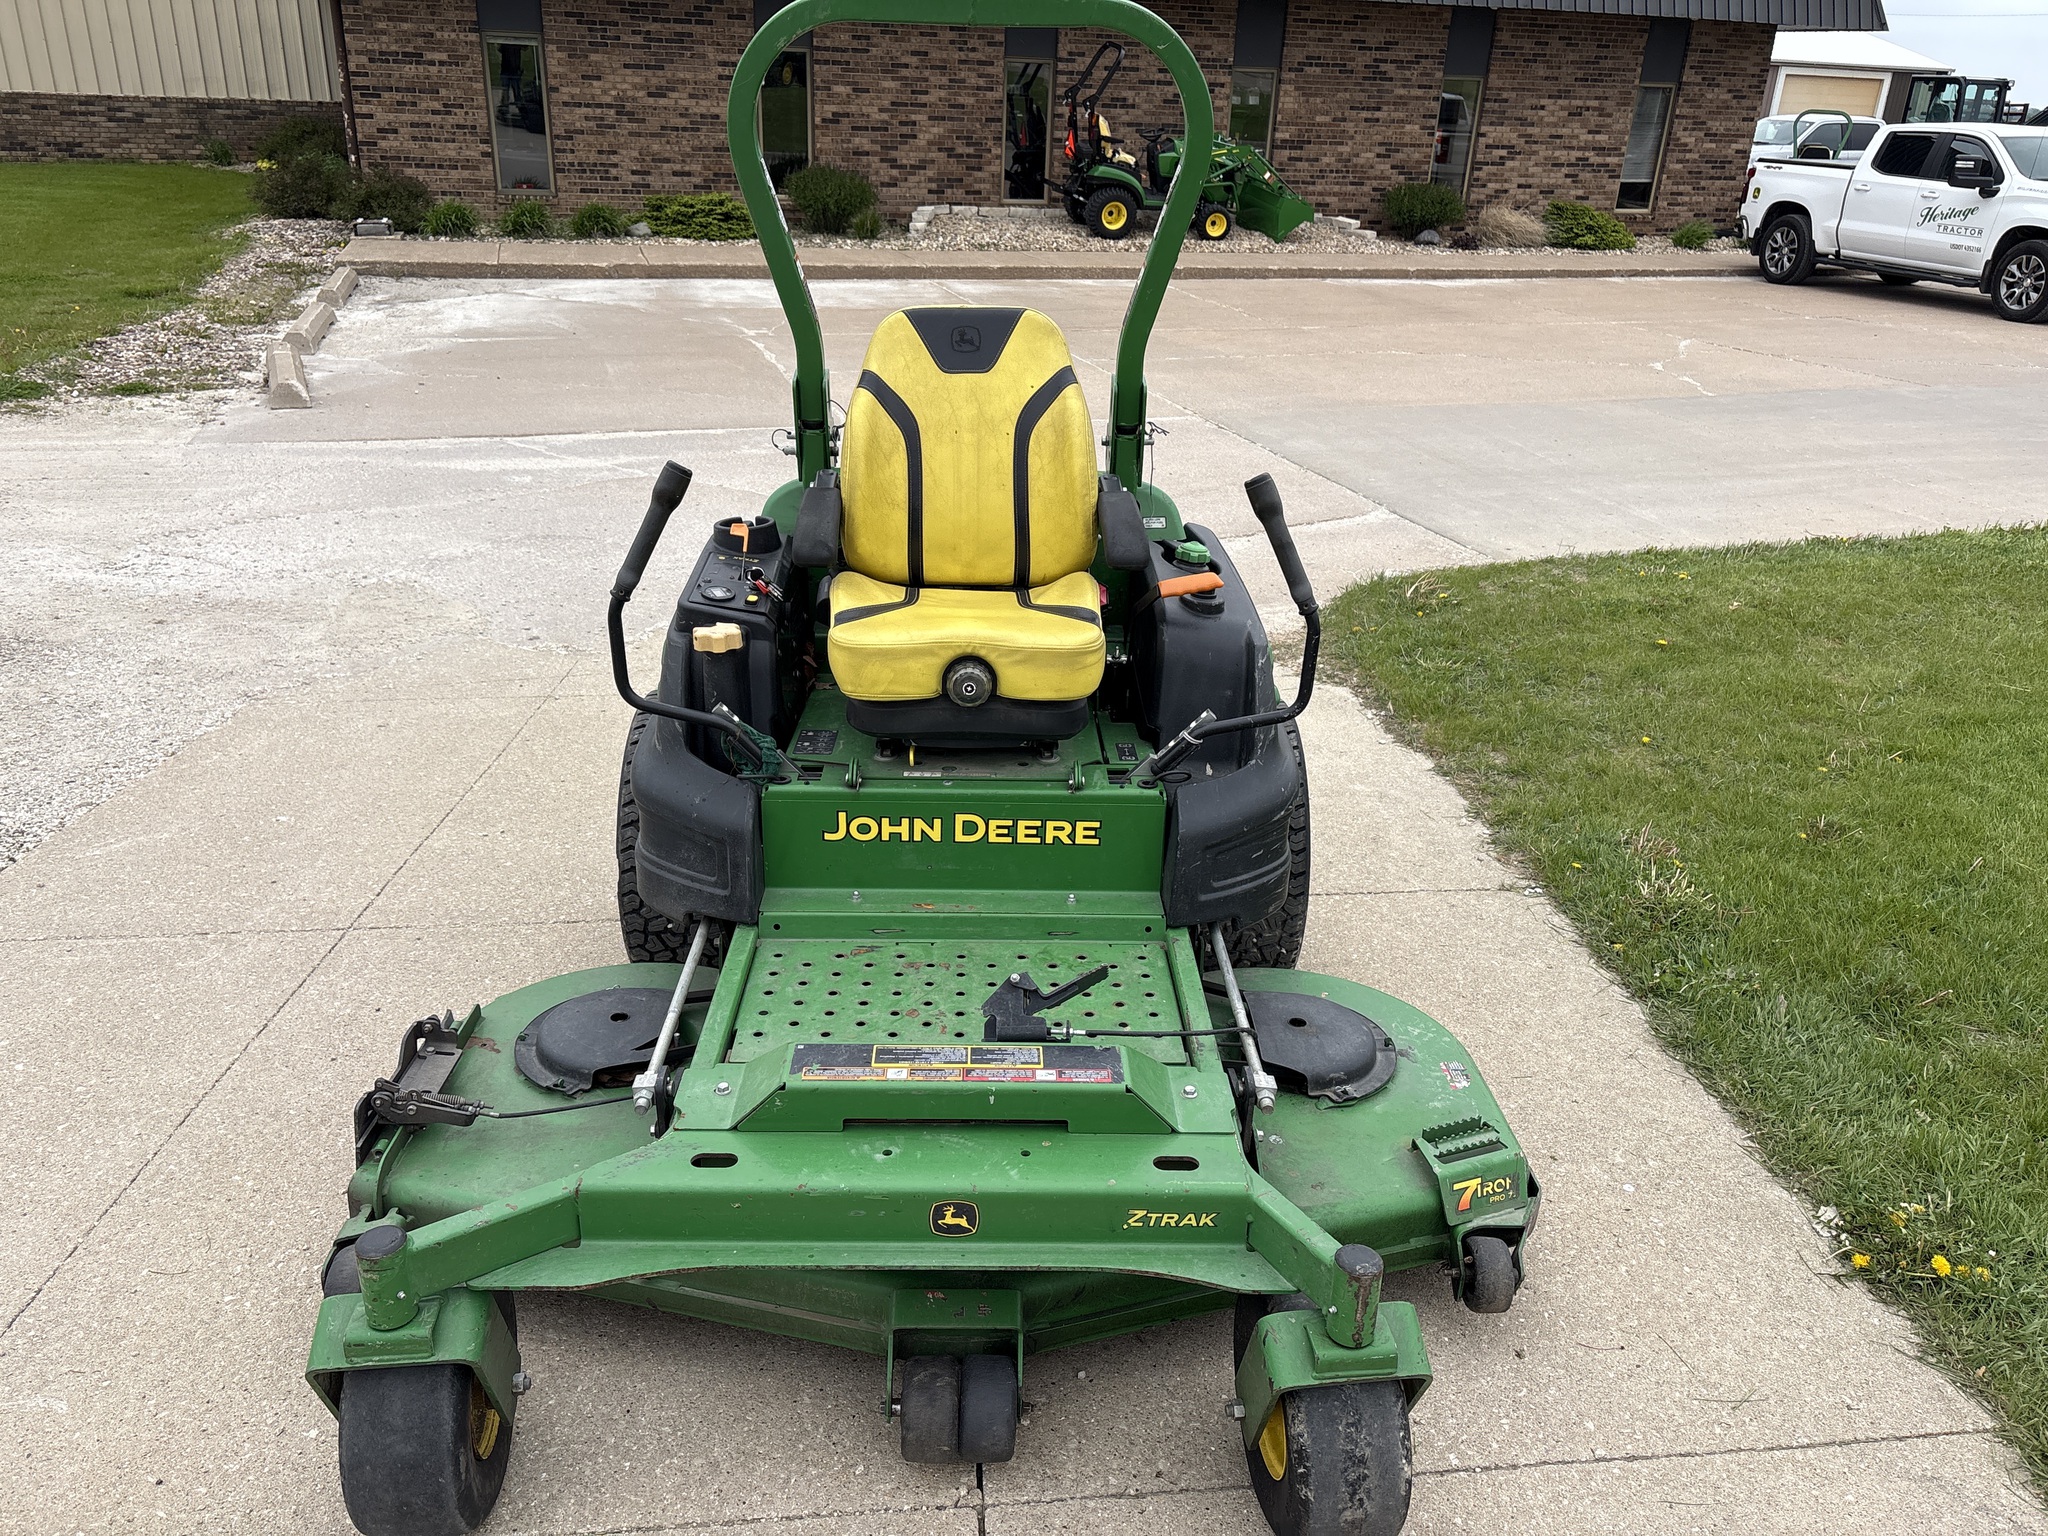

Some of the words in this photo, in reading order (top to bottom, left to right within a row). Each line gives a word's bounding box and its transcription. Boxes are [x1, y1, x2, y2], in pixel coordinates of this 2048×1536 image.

[1916, 204, 1980, 228] Heritage
[1937, 224, 1984, 237] TRACTOR
[823, 810, 943, 843] JOHN
[953, 812, 1102, 846] DEERE
[1489, 1193, 1506, 1204] PRO
[1122, 1209, 1219, 1230] ZTRAK
